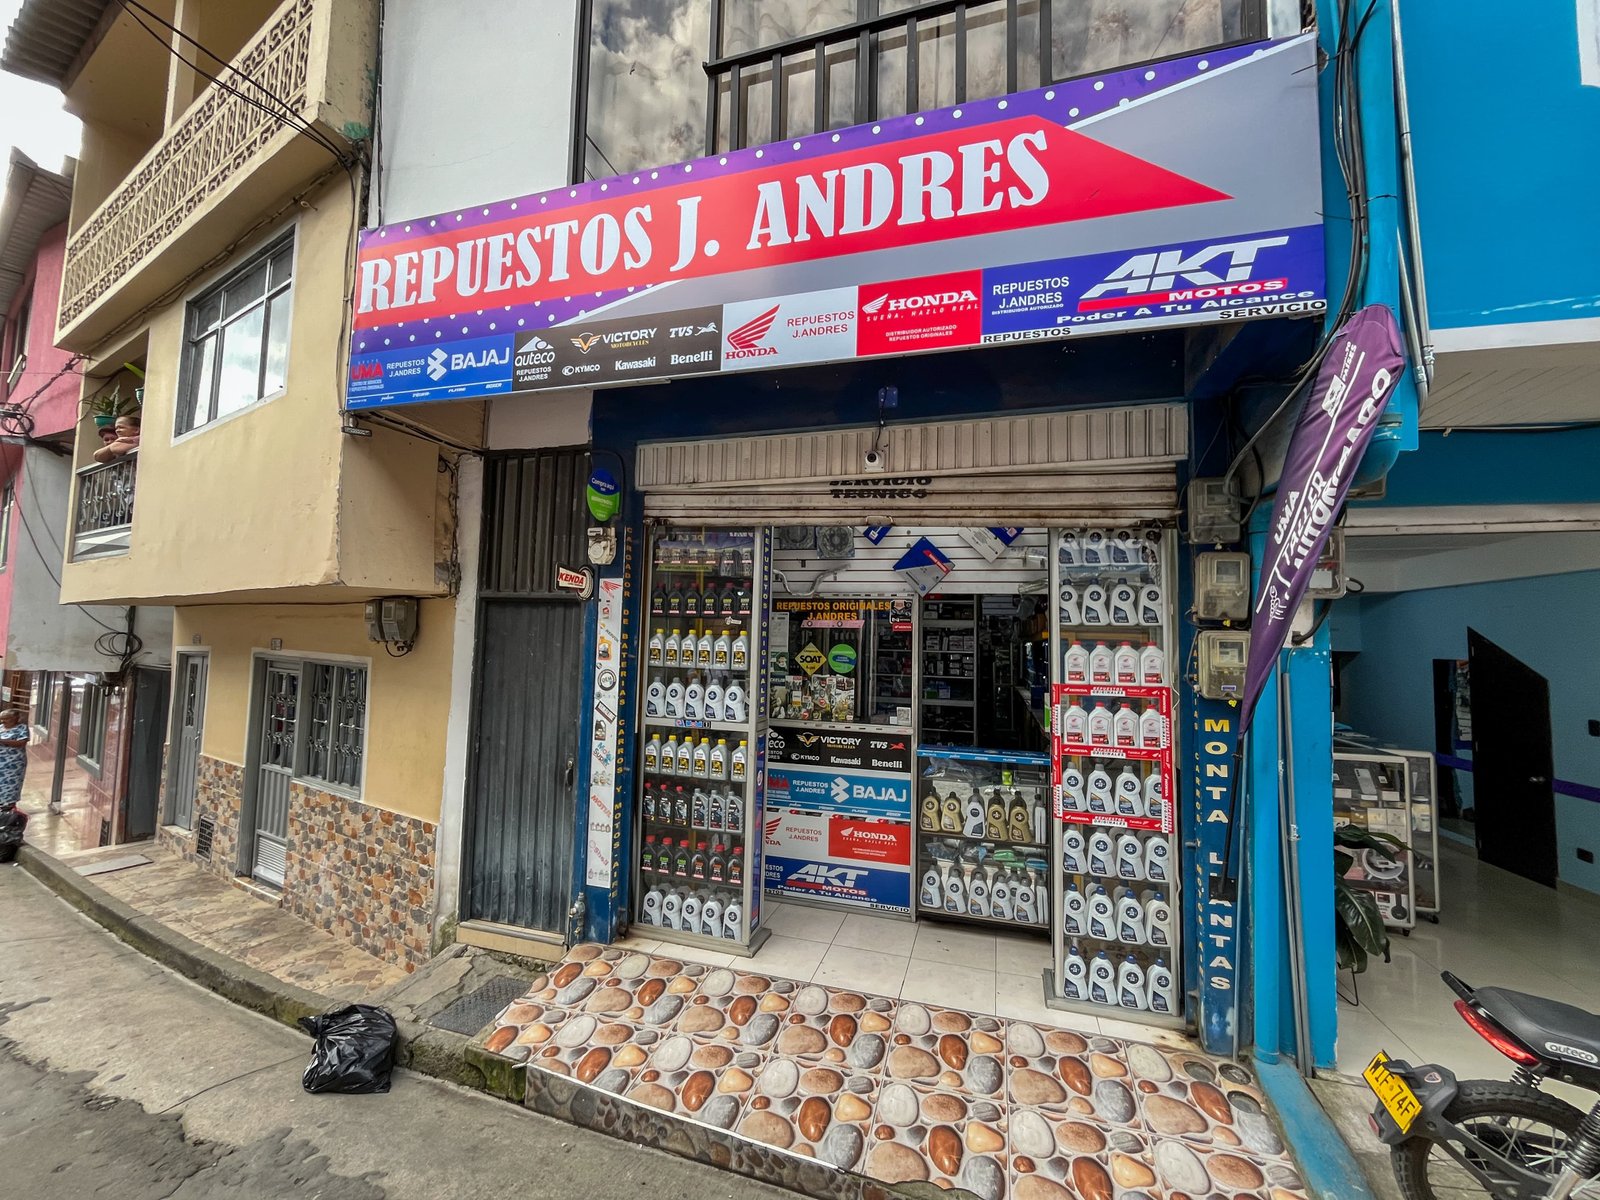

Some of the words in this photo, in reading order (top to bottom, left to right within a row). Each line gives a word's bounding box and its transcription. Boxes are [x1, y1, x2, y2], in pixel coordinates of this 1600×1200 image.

[357, 204, 652, 314] REPUESTOS
[669, 195, 720, 273] J.
[746, 129, 1050, 250] ANDRES
[1079, 236, 1289, 299] AKT
[992, 276, 1070, 295] REPUESTOS
[1168, 279, 1285, 302] MOTOS
[888, 290, 978, 311] HONDA
[998, 291, 1063, 309] J.ANDRES
[1056, 310, 1127, 324] Poder
[1133, 306, 1153, 316] A
[1159, 303, 1192, 314] Tu
[1200, 289, 1315, 309] Alcance
[911, 307, 945, 317] HAZLO
[952, 303, 979, 312] REAL
[1219, 300, 1326, 320] SERVICIO
[787, 310, 855, 328] REPUESTOS
[602, 328, 658, 344] VICTORY
[669, 325, 694, 339] TVS
[792, 323, 848, 339] J.ANDRES
[885, 328, 922, 337] DISTRIBUIDOR
[922, 324, 957, 333] AUTORIZADO
[889, 334, 920, 342] REPUESTOS
[920, 330, 953, 339] ORIGINALES
[983, 327, 1071, 343] REPUESTOS
[451, 347, 510, 371] BAJAJ
[514, 351, 556, 367] auteco
[670, 350, 713, 365] Benelli
[725, 346, 778, 360] HONDA
[351, 362, 384, 380] UMA
[386, 358, 425, 370] REPUESTOS
[516, 366, 552, 376] REPUESTOS
[574, 363, 601, 373] KYMCO
[615, 356, 657, 371] Kawasaki
[389, 367, 422, 378] J.ANDRES
[518, 374, 549, 382] J.ANDRES
[558, 572, 584, 585] KENDA
[776, 602, 830, 611] REPUESTOS
[832, 601, 891, 611] ORIGINALES
[622, 609, 630, 625] DE
[807, 612, 858, 621] J.ANDRES
[800, 655, 822, 664] SOAT
[619, 633, 629, 705] BATERIAS
[616, 720, 625, 773] CARROS
[820, 736, 861, 746] VICTORY
[869, 740, 888, 749] TVS
[830, 755, 861, 766] Kawasaki
[871, 759, 903, 769] Benelli
[1204, 719, 1231, 824] MONTA
[615, 785, 622, 793] Y
[792, 780, 829, 789] REPUESTOS
[795, 786, 826, 795] J.ANDRES
[853, 785, 907, 803] BAJAJ
[785, 826, 823, 836] REPUESTOS
[788, 834, 819, 842] J.ANDRES
[853, 831, 897, 842] HONDA
[786, 863, 869, 888] AKT
[777, 884, 805, 893] Poder
[834, 892, 878, 903] Alcance
[822, 885, 867, 896] MOTOS
[869, 903, 910, 913] SERVICIO
[1208, 852, 1233, 990] LANTAS
[1549, 1043, 1593, 1063] auteco
[1390, 1084, 1416, 1117] 74F
